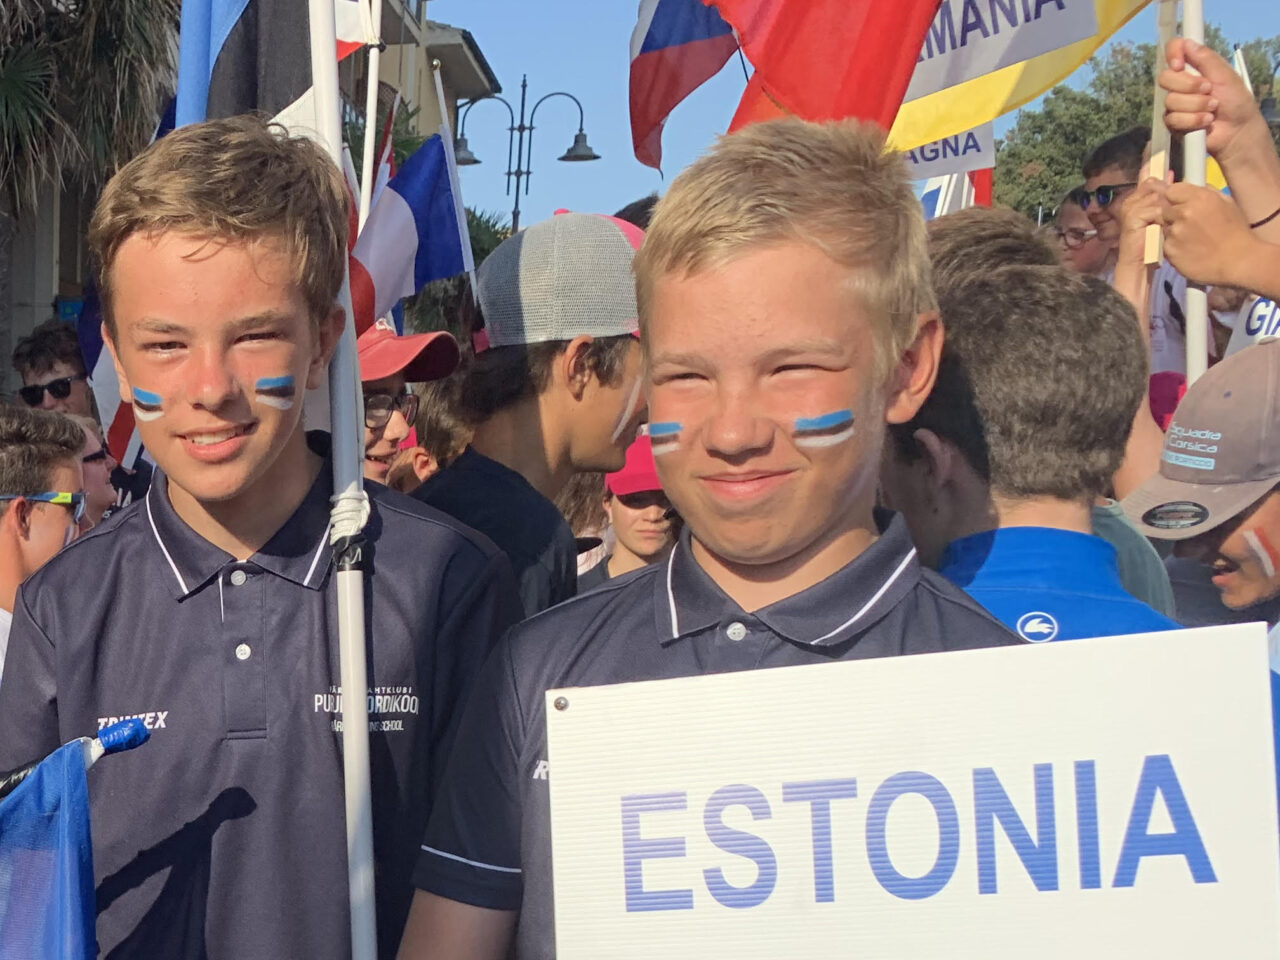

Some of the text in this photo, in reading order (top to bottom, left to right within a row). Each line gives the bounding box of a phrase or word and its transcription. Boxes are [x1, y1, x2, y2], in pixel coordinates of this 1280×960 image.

[1170, 421, 1222, 440] Squadra
[1168, 434, 1218, 453] Corsica
[621, 753, 1219, 913] ESTONIA
